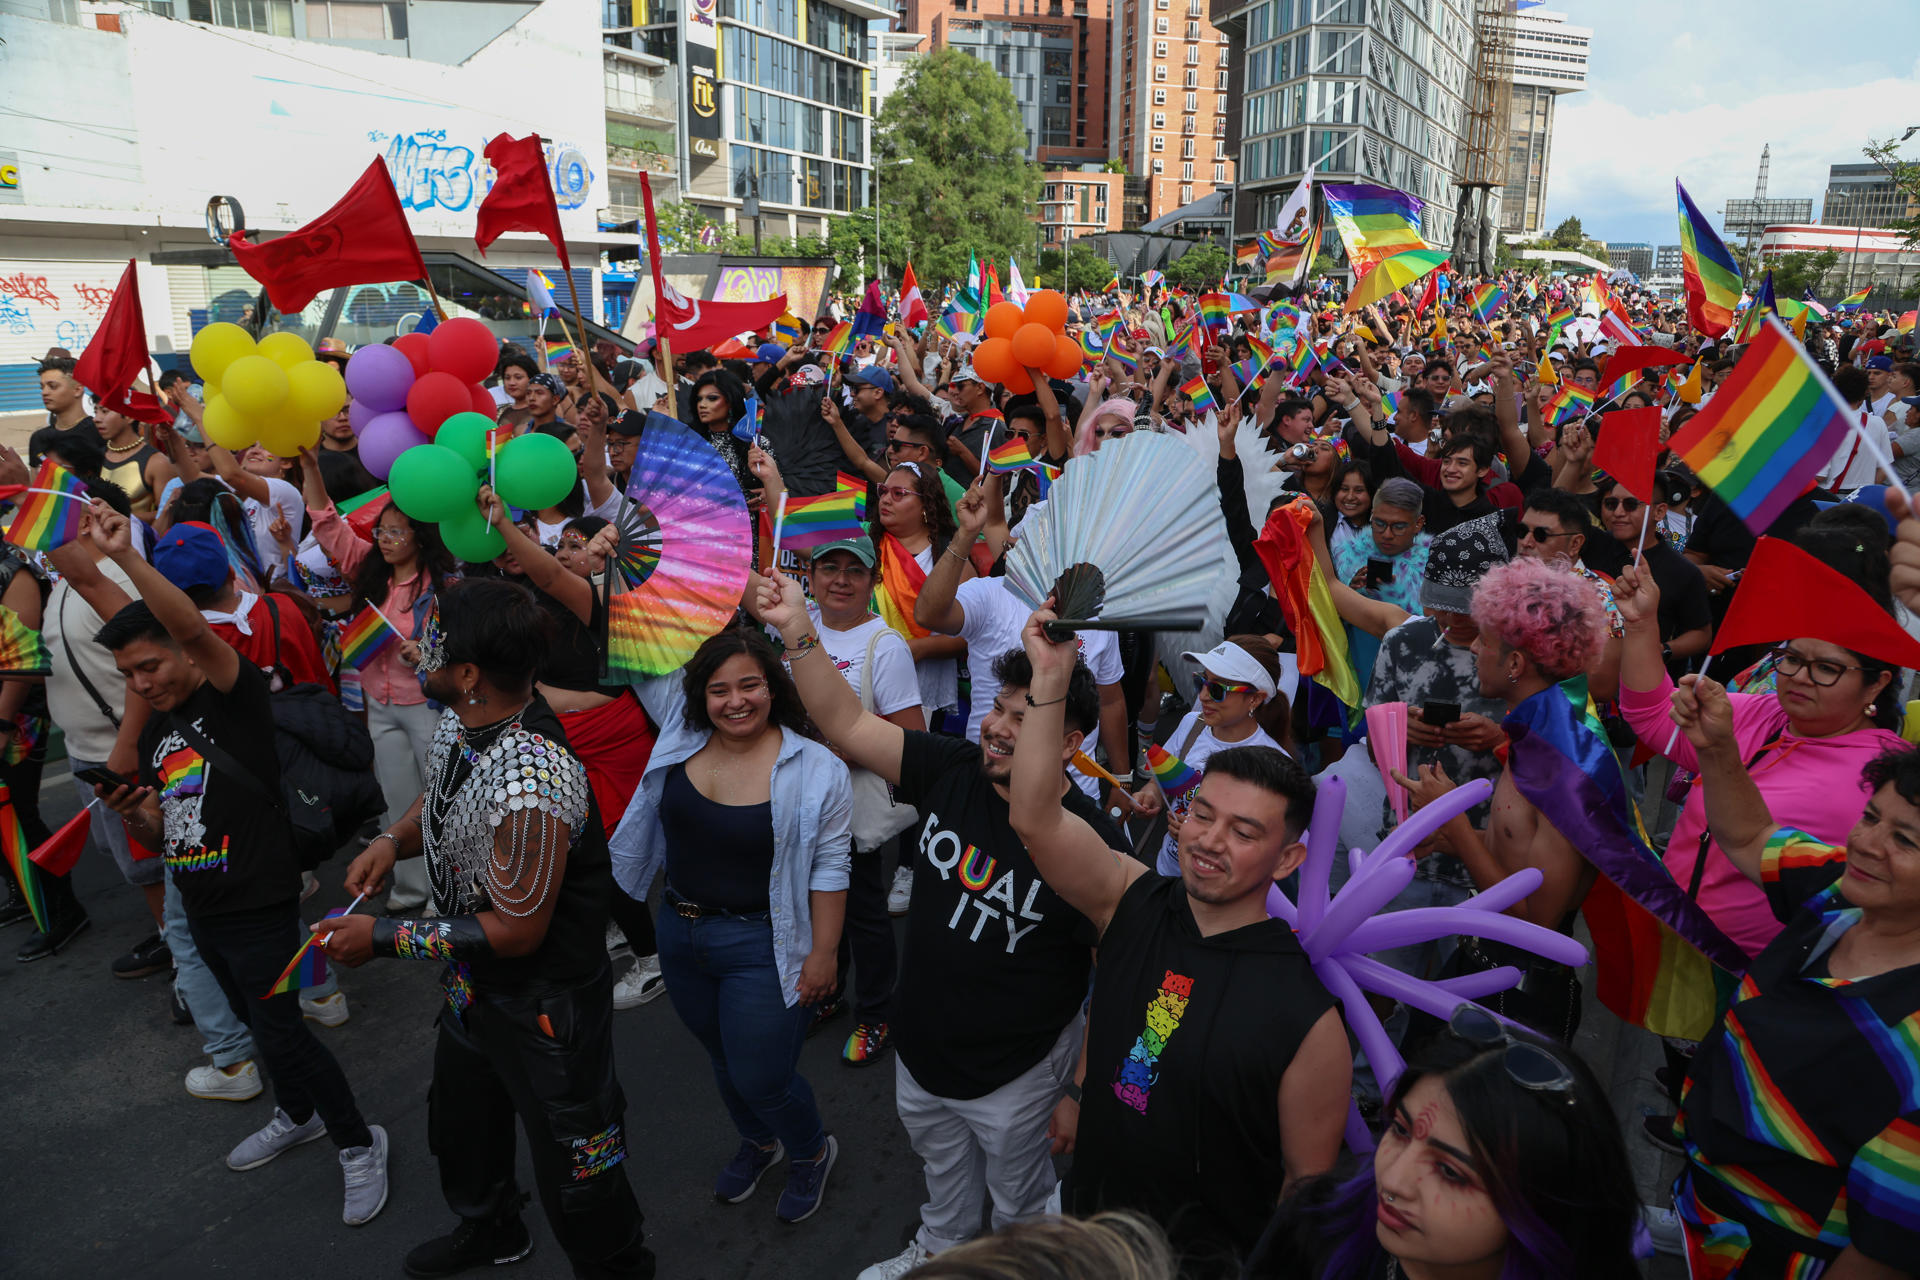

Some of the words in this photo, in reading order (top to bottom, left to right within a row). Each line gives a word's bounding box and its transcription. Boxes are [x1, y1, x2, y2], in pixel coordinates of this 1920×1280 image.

[692, 76, 714, 108] fit
[919, 812, 1044, 921] EQUAL
[948, 892, 1038, 953] ITY
